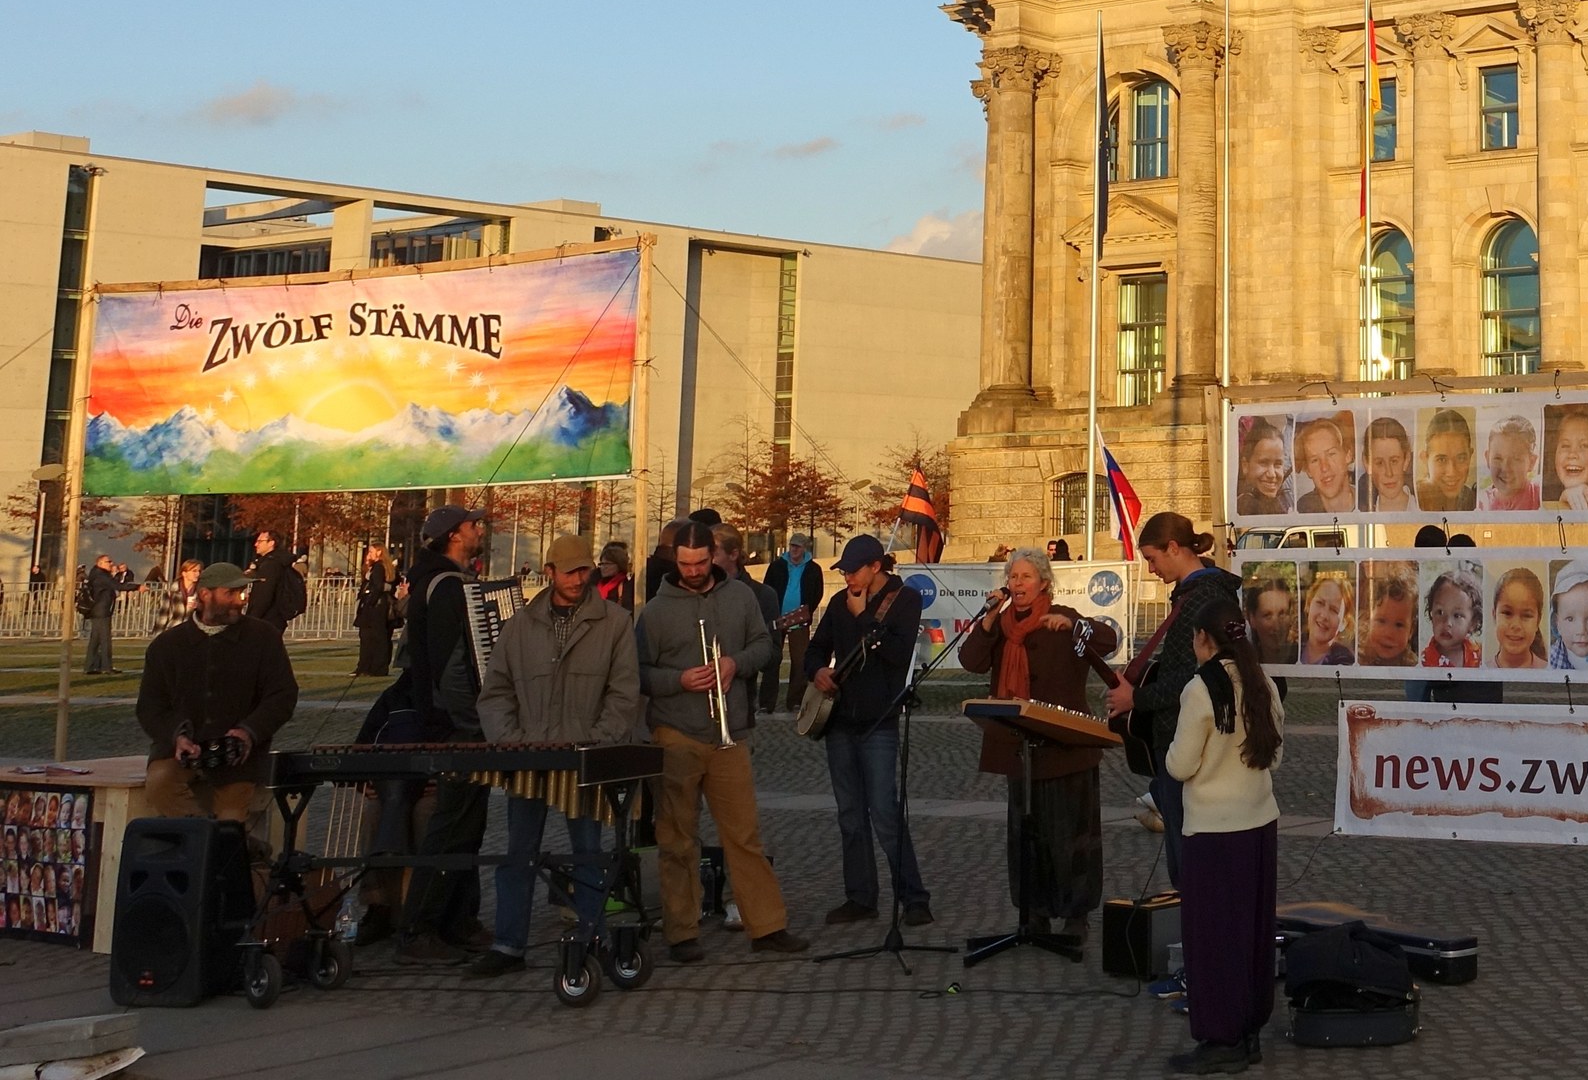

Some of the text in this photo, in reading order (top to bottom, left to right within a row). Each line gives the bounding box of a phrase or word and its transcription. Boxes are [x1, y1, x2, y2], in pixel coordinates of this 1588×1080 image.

[170, 302, 503, 373] Die ZWÖLF STÄMME
[919, 588, 934, 597] 139
[939, 588, 956, 598] Die
[957, 588, 979, 598] BRD
